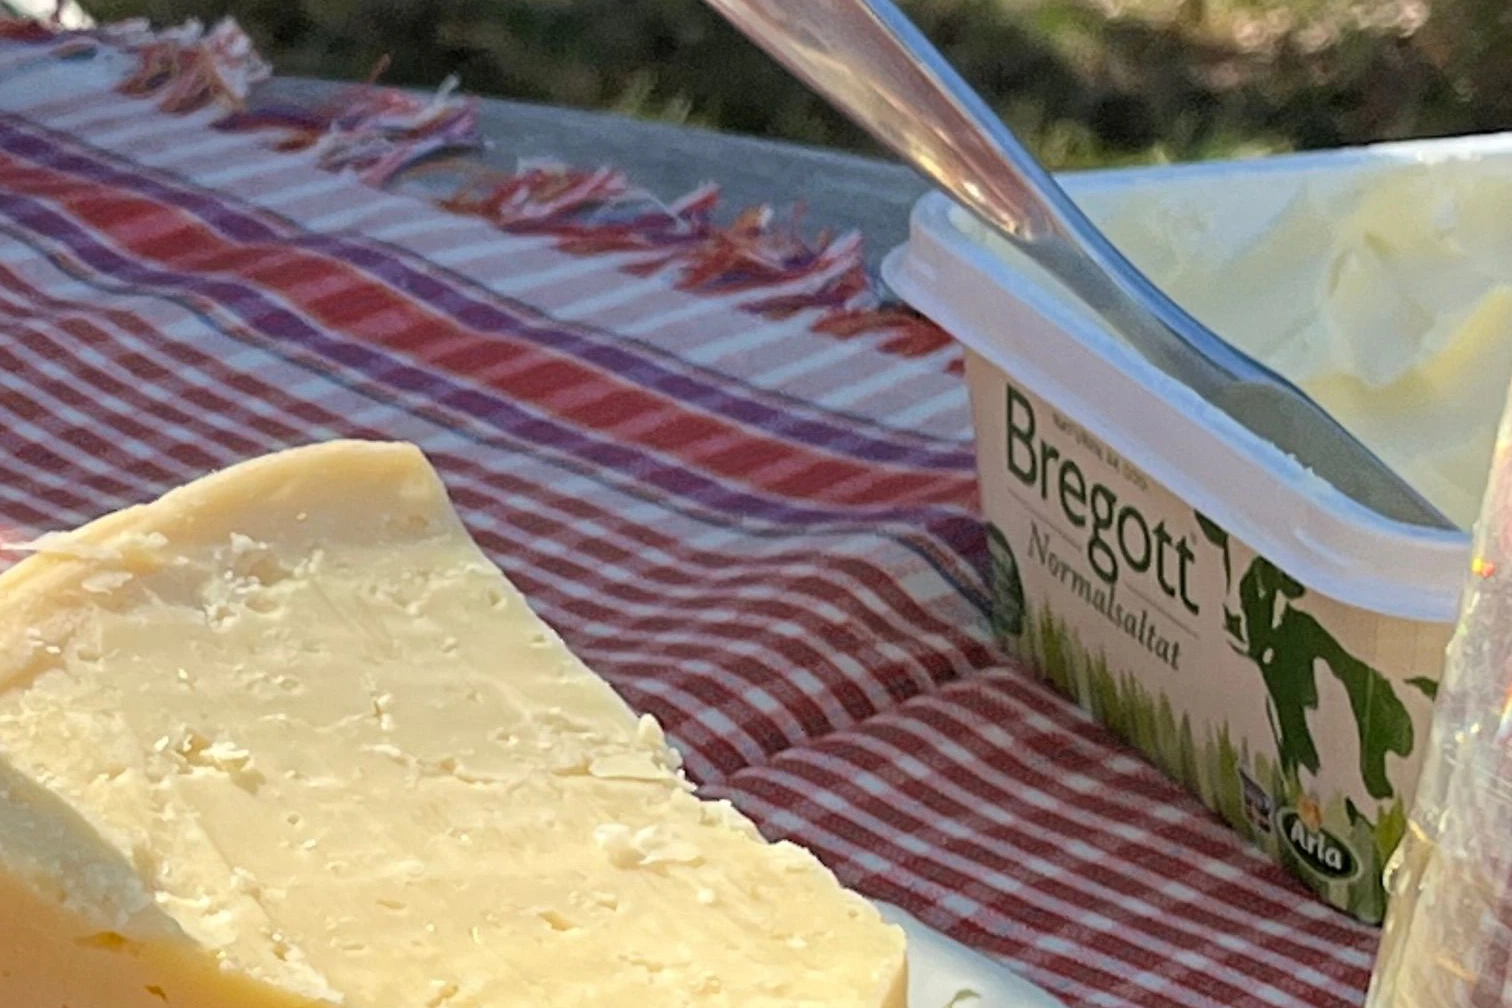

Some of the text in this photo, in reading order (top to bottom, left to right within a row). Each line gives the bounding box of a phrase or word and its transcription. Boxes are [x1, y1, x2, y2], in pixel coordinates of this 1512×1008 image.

[1007, 382, 1200, 616] Bregott
[1028, 519, 1182, 671] Normalsaltat
[1290, 818, 1343, 871] Arla
